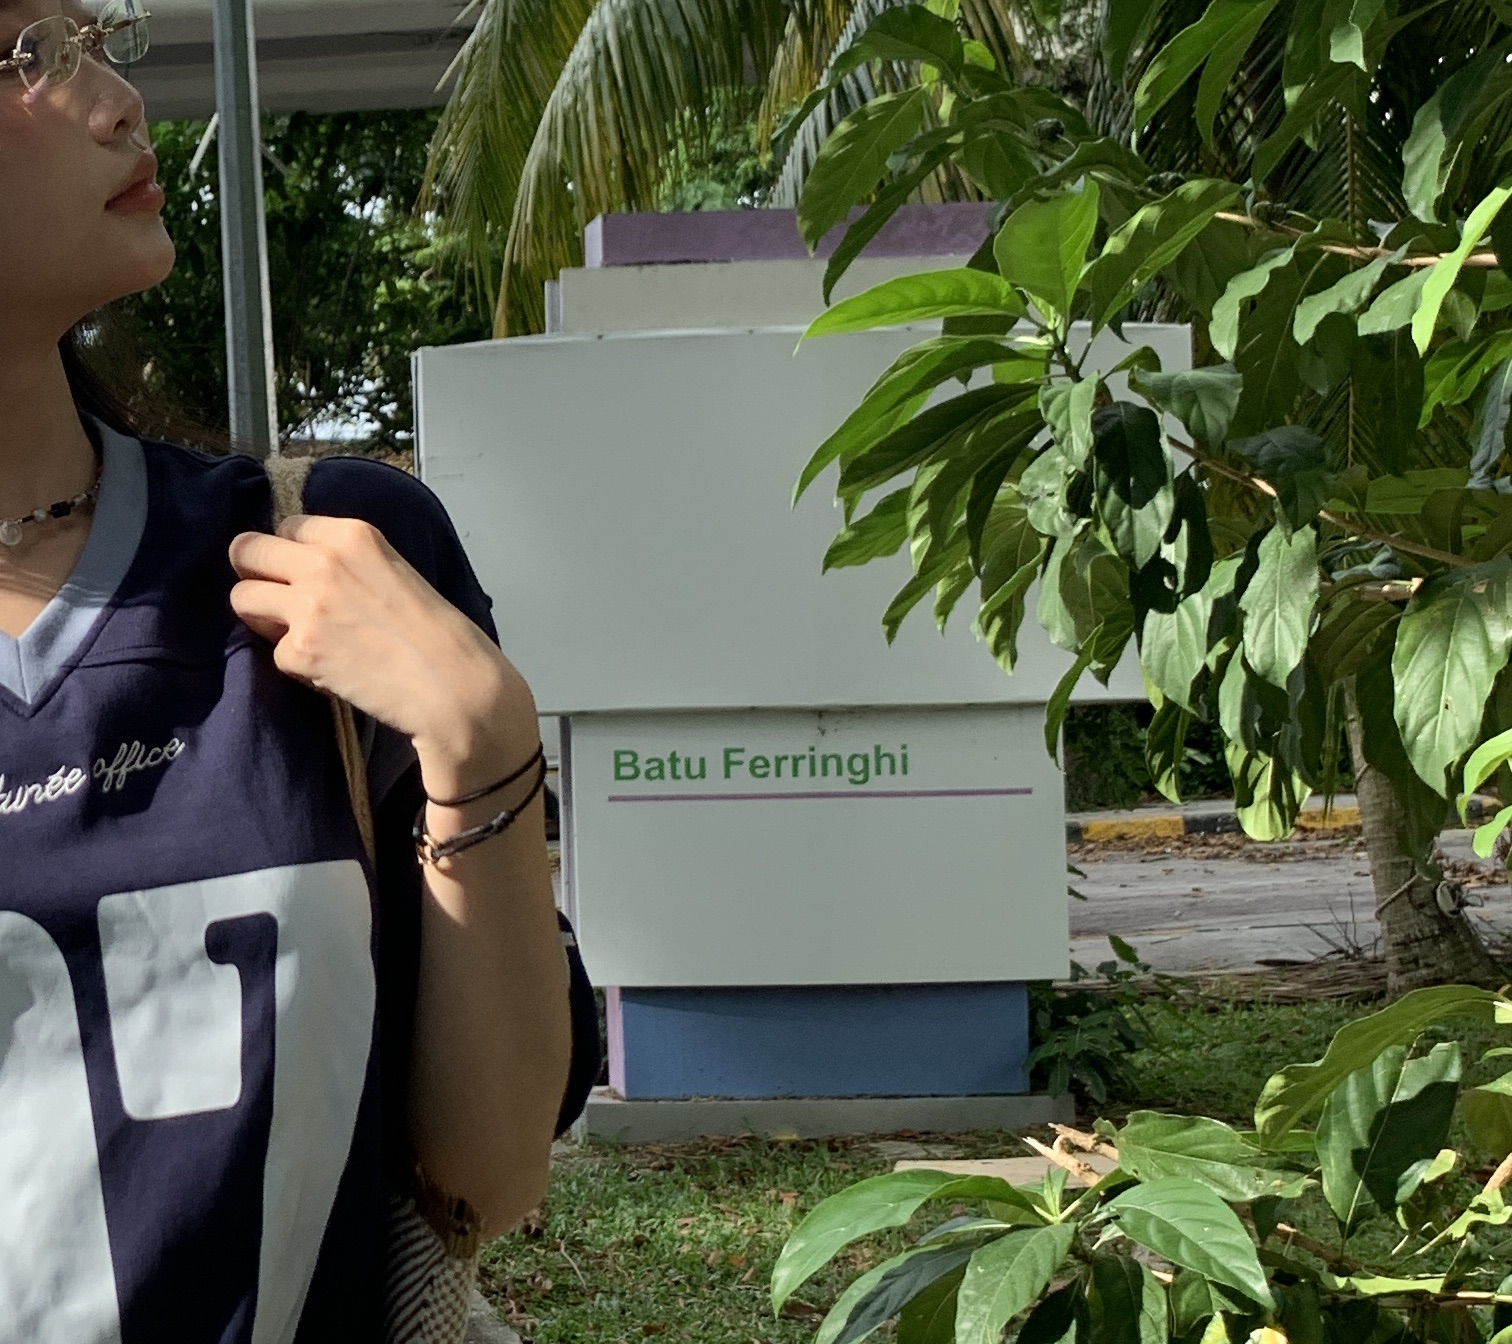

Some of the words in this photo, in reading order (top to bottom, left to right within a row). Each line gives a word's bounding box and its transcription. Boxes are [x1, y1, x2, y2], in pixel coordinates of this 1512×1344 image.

[93, 737, 186, 793] office
[612, 749, 707, 781] Batu
[722, 744, 909, 786] Ferringhi
